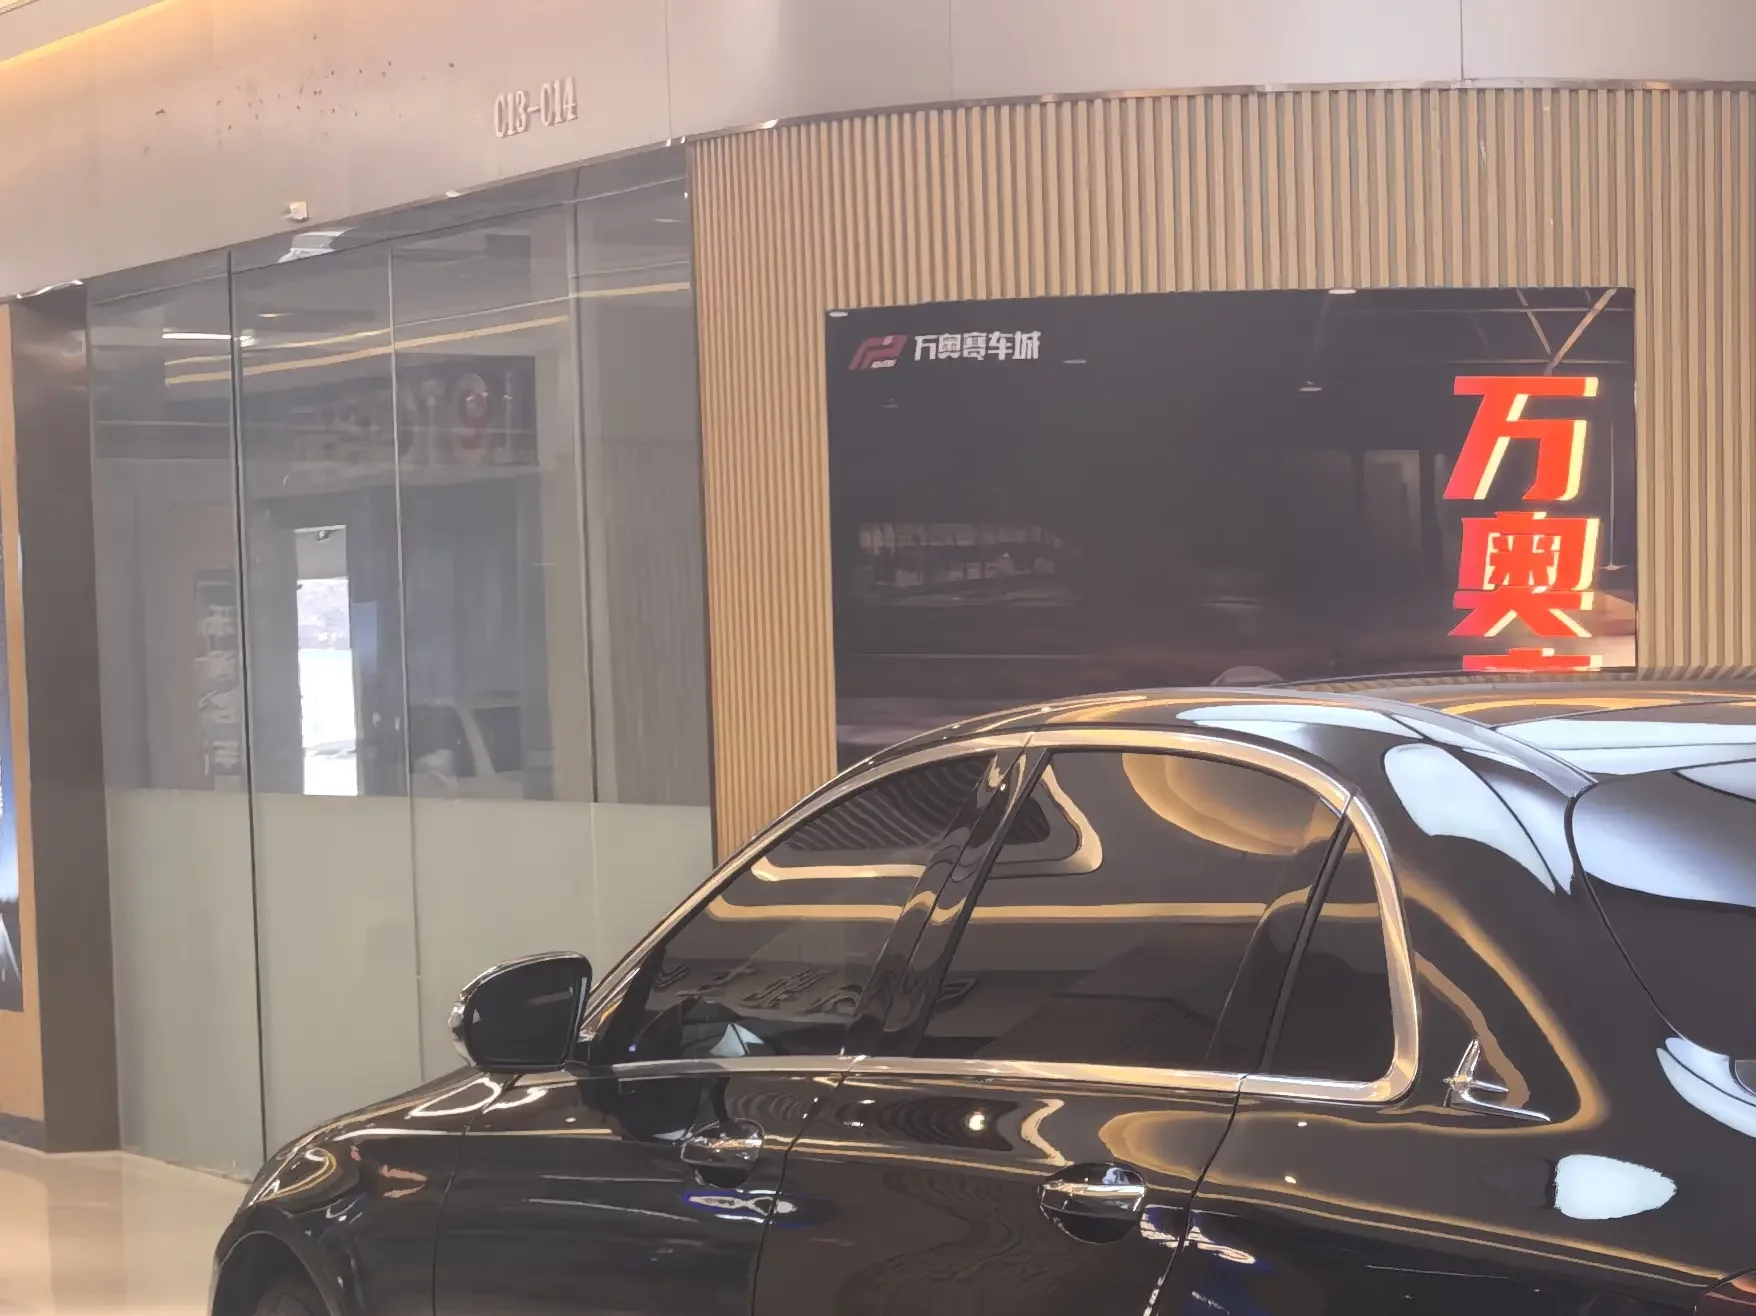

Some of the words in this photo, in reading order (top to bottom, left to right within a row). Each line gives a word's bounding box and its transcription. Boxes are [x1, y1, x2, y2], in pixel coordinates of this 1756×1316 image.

[494, 76, 578, 138] C13-C14
[914, 331, 1042, 361] 万奥赛车城
[1443, 373, 1603, 671] 万奥
